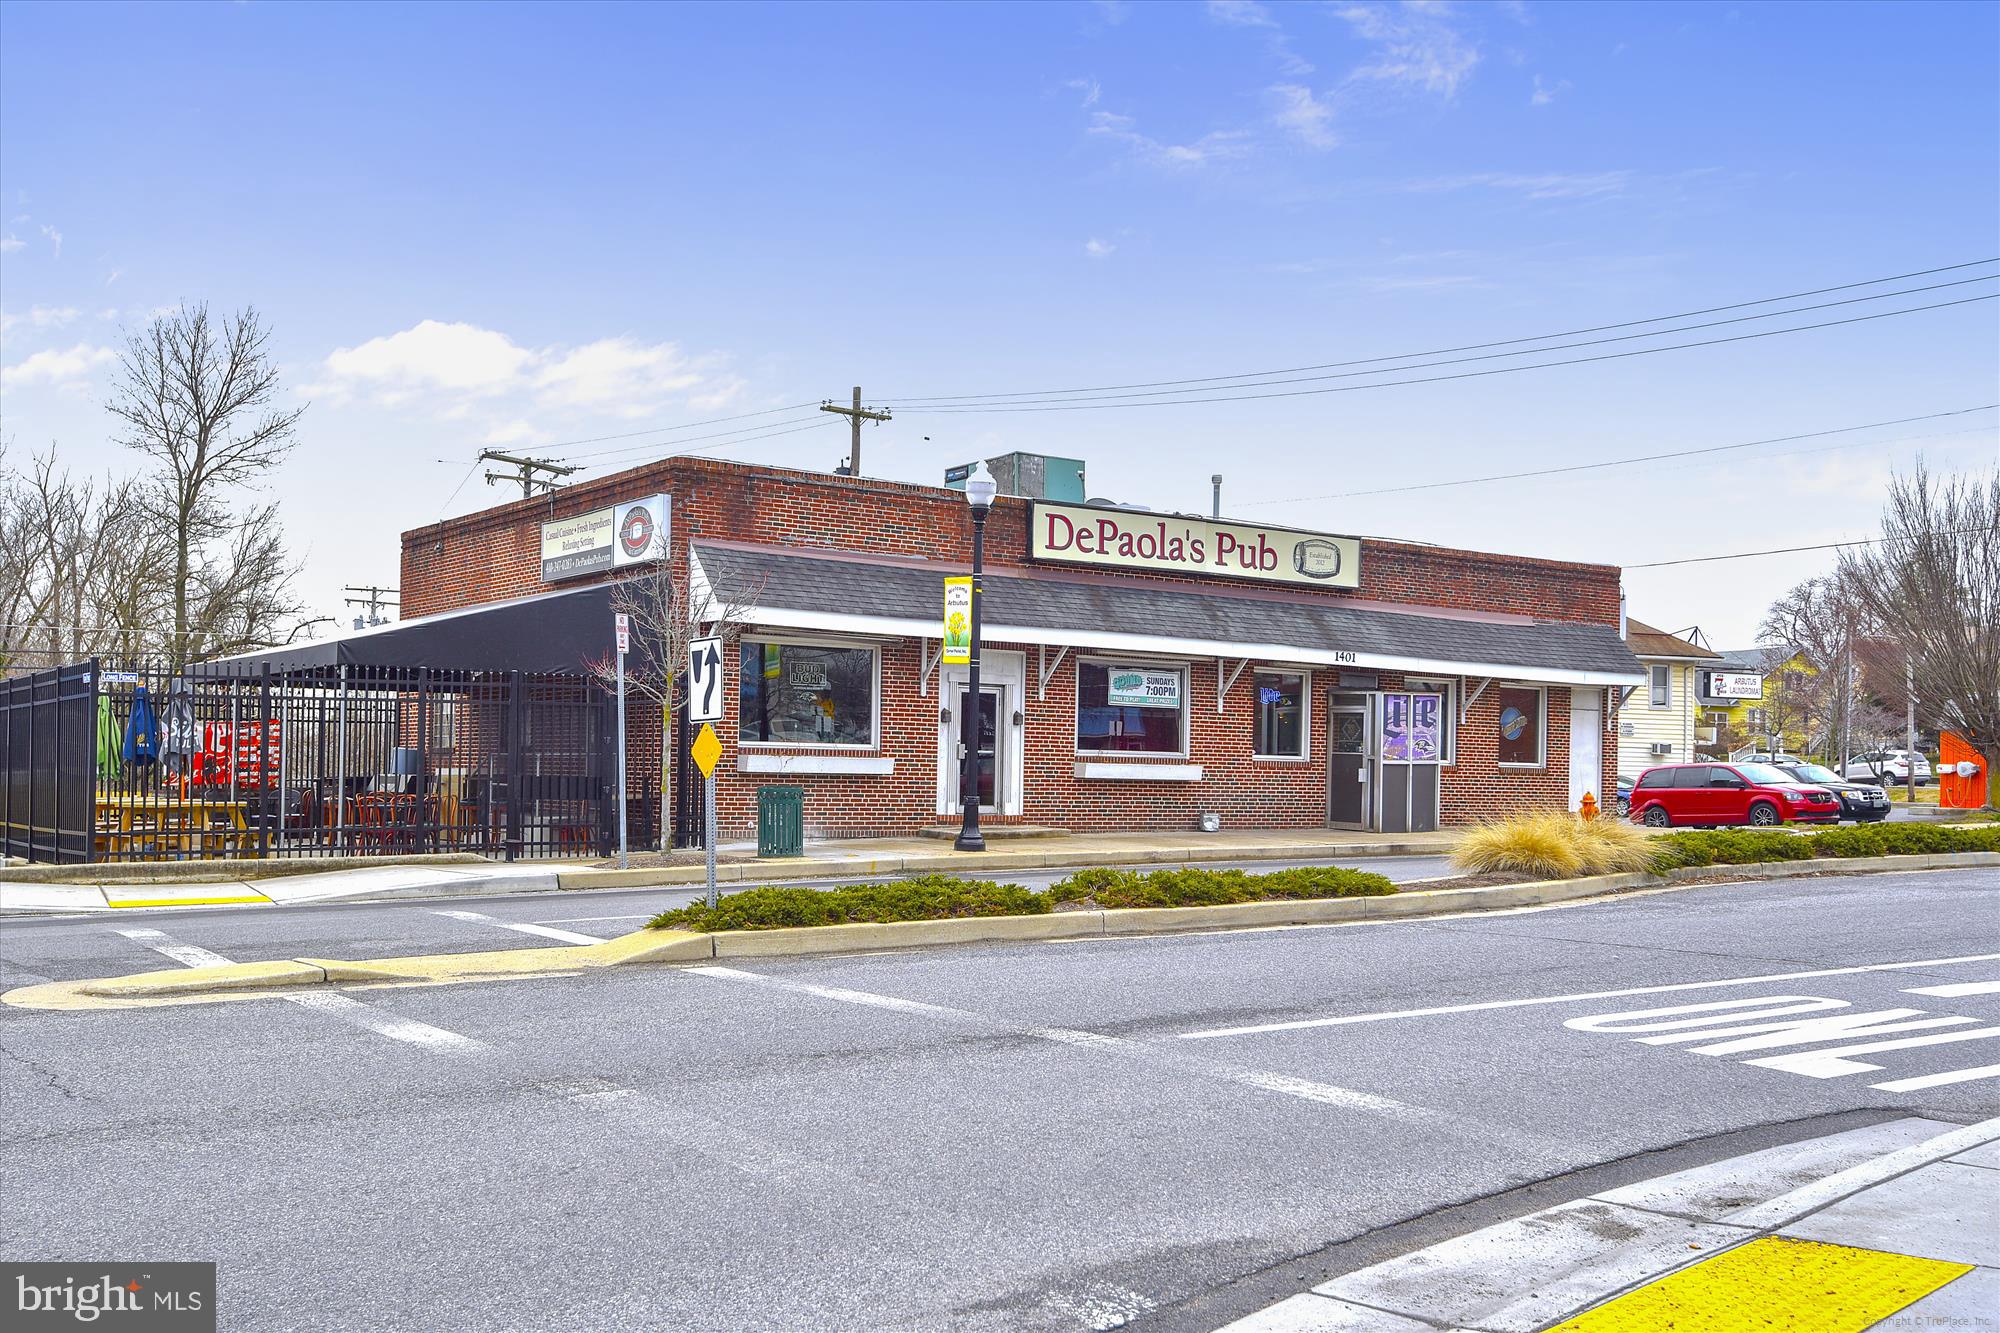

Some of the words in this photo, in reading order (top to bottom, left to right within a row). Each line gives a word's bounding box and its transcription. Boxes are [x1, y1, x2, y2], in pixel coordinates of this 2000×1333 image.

[546, 526, 559, 541] Casual
[559, 525, 574, 539] Cuisine
[577, 520, 589, 534] Fresh
[589, 517, 612, 533] Ingredients
[562, 540, 580, 552] Relaxing
[580, 536, 595, 549] Setting
[1045, 513, 1205, 564] DePaola's
[1215, 532, 1278, 572] Pub
[948, 586, 968, 595] Welcome
[1334, 651, 1356, 662] 1401
[796, 663, 820, 673] BUD
[120, 673, 137, 681] FENCE
[792, 672, 825, 684] LIGHT
[1146, 676, 1175, 686] SUNDAYS
[1735, 677, 1757, 686] ARBUTUS
[1145, 685, 1176, 697] 7:00PM
[1260, 687, 1281, 705] Lite
